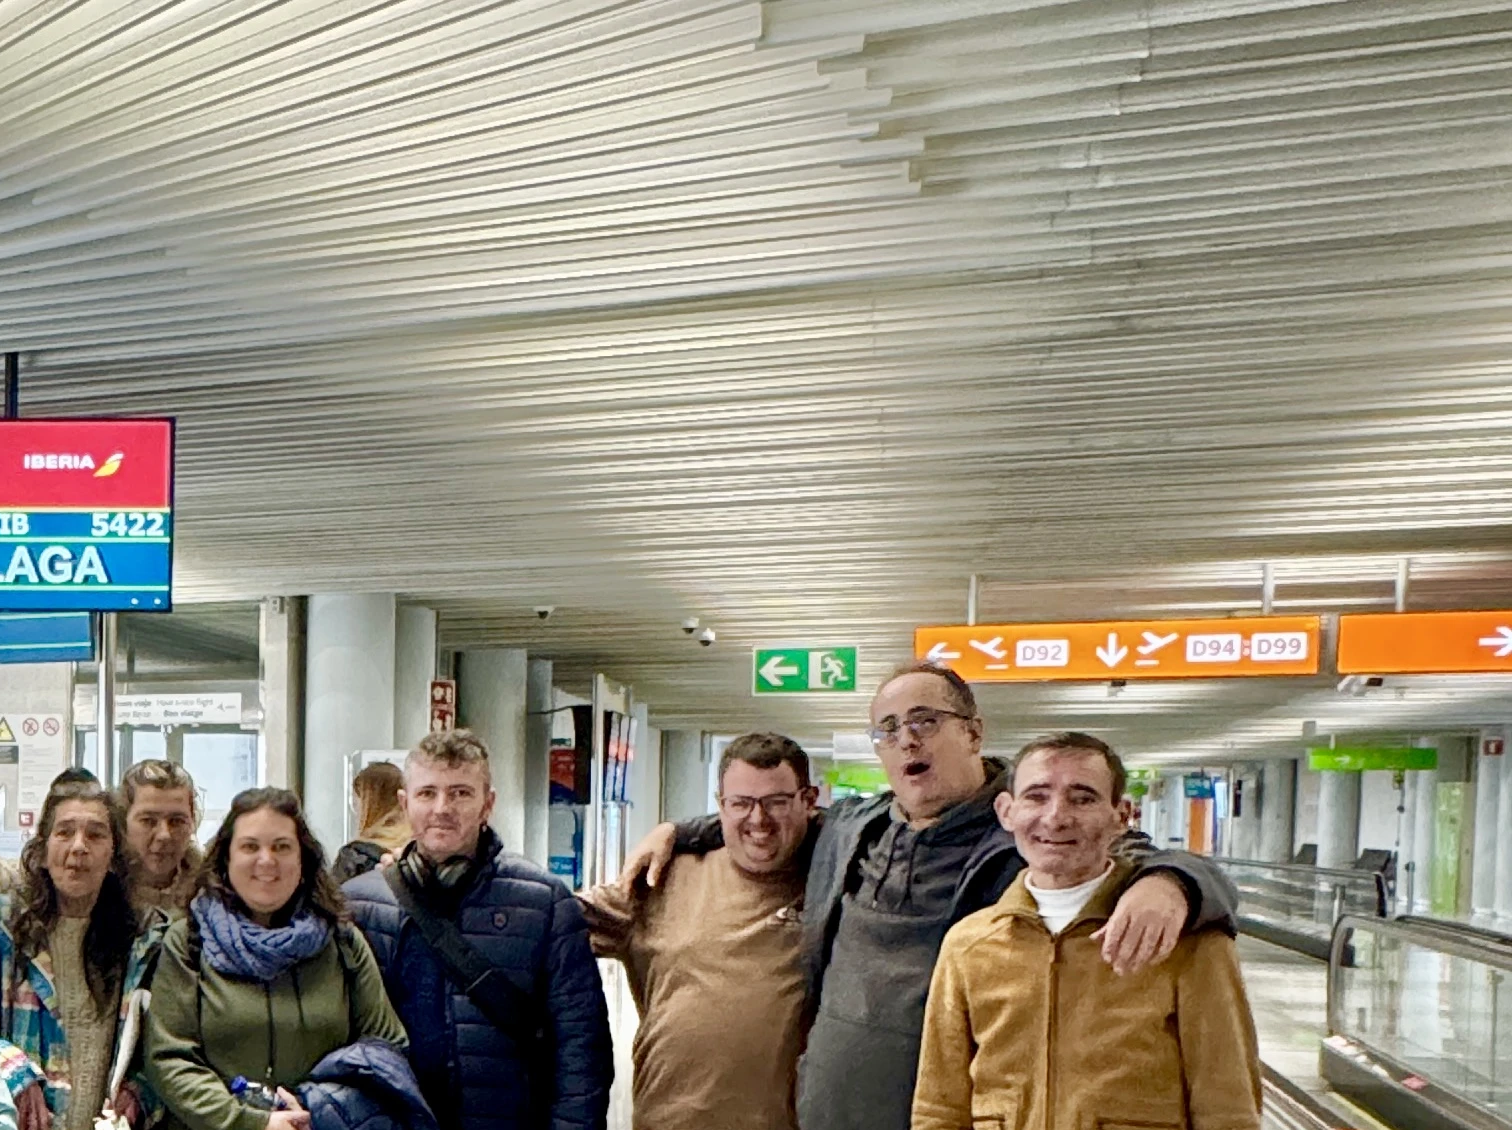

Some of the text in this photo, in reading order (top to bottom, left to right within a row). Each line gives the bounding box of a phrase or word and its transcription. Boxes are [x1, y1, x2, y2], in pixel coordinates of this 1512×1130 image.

[23, 454, 96, 469] IBERIA
[90, 512, 165, 537] 5422
[1021, 645, 1063, 661] D92
[1192, 638, 1302, 657] D94 D99
